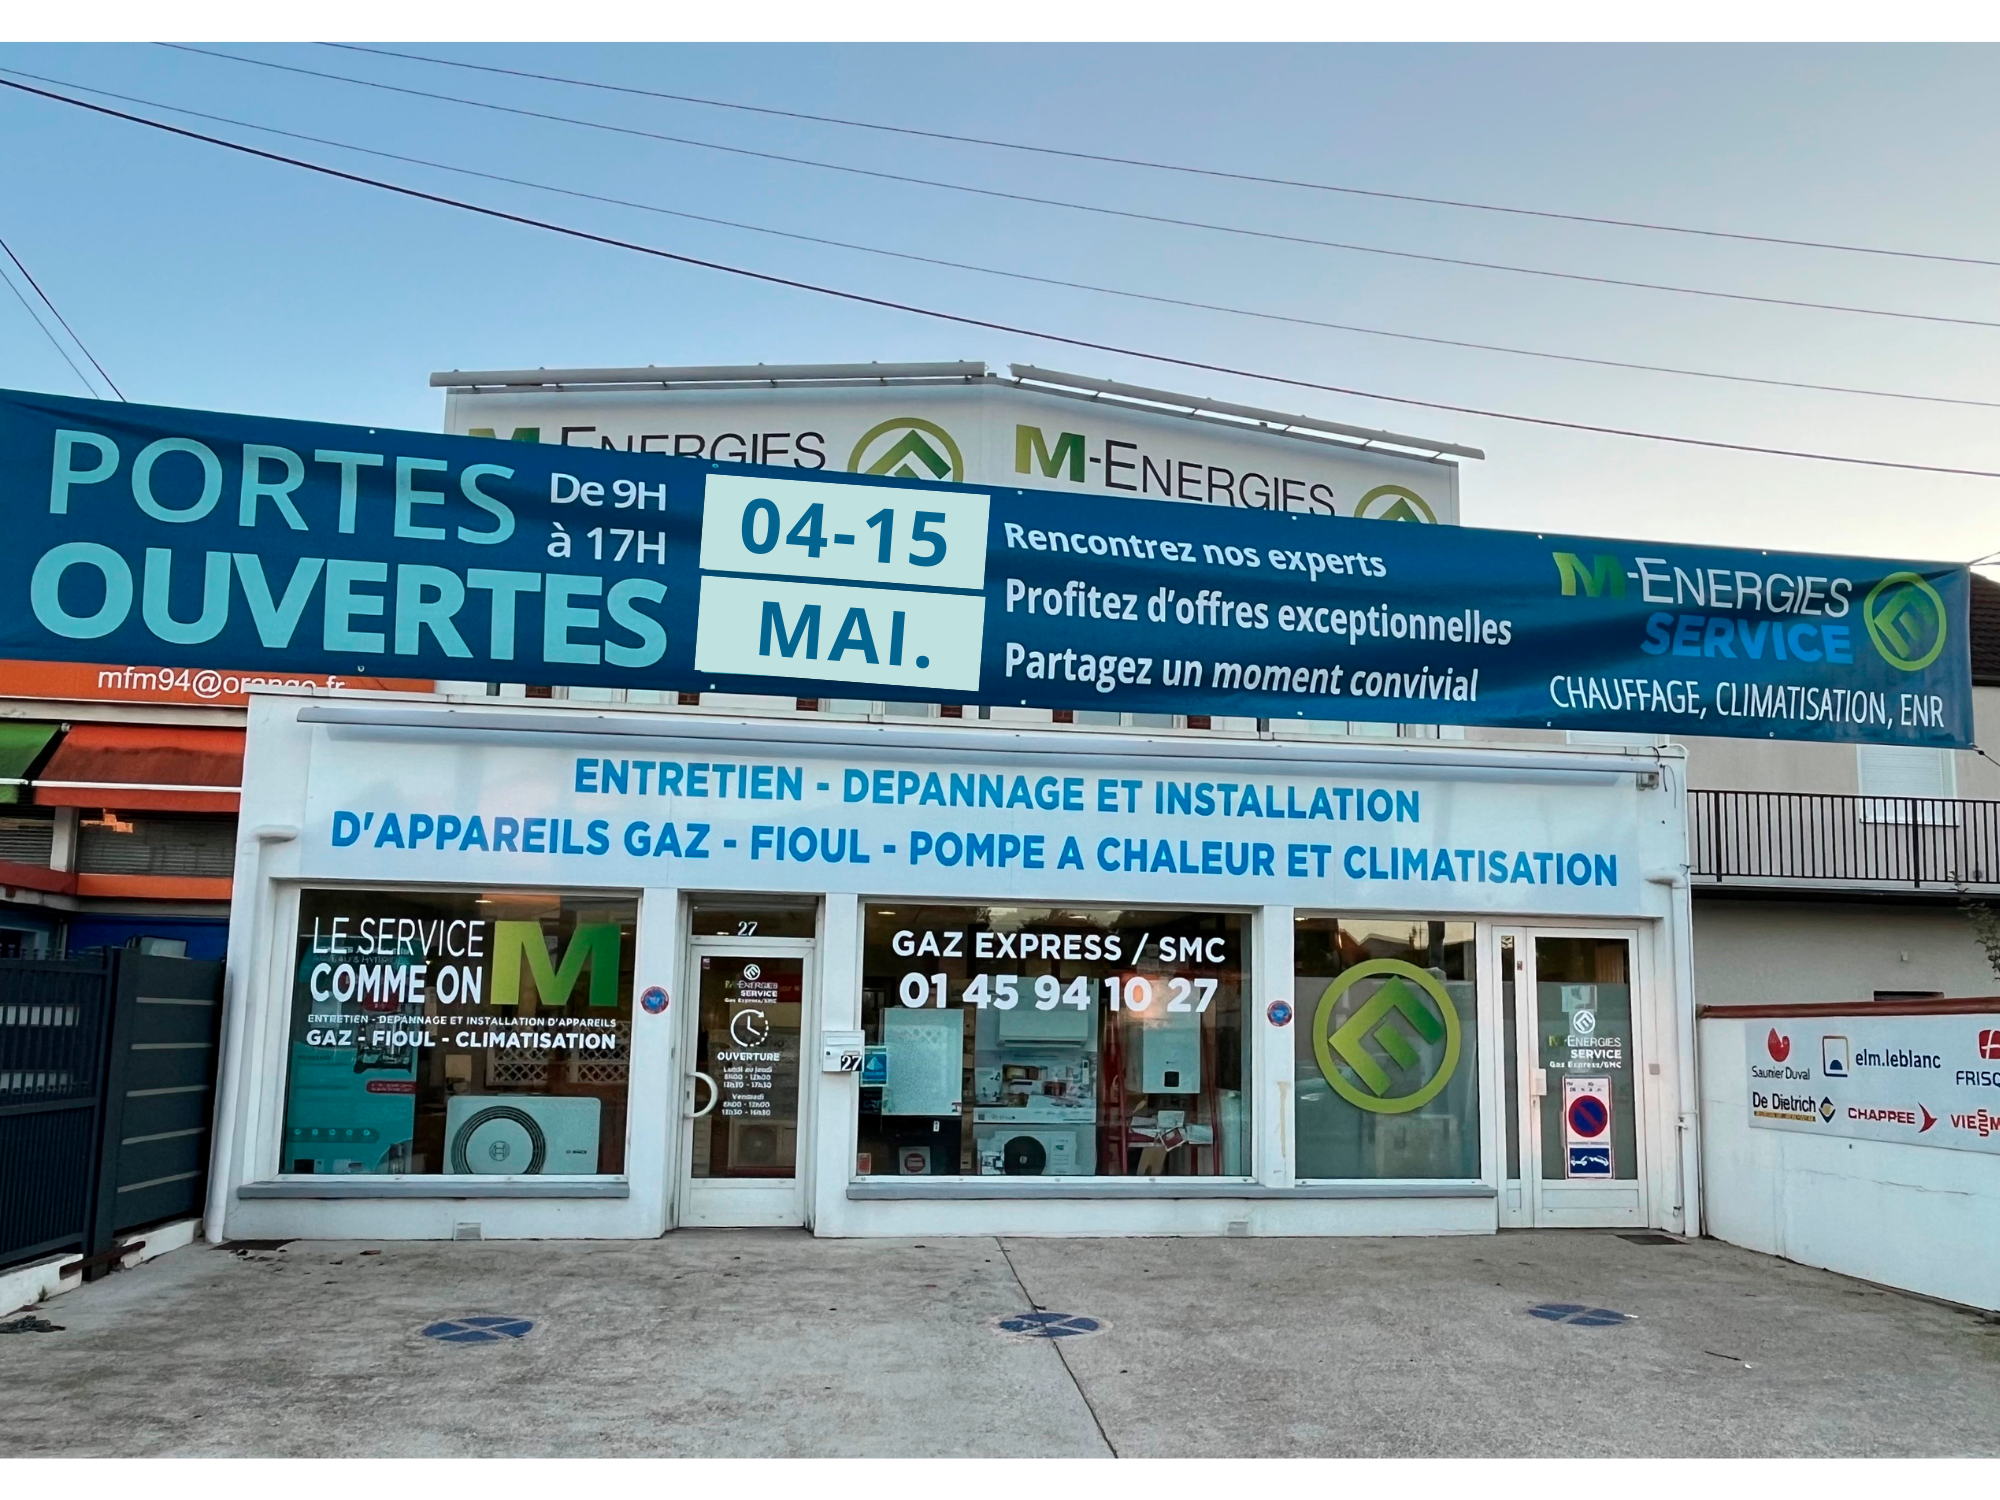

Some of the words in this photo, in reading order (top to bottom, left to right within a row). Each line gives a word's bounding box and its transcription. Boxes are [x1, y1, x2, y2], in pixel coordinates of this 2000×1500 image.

[48, 428, 517, 545] PORTES
[549, 472, 605, 507] De
[611, 480, 667, 511] 9H
[547, 521, 572, 558] à
[586, 528, 667, 565] 17H
[740, 498, 949, 567] 04-15
[1004, 522, 1197, 563] Rencontrez
[1203, 544, 1261, 568] nos
[1268, 549, 1387, 582] experts
[30, 541, 668, 668] OUVERTES
[1006, 578, 1139, 621] Profitez
[1278, 603, 1512, 646] exceptionnelles
[758, 600, 932, 669] MAI.
[1640, 612, 1853, 665] SERVICE
[1005, 642, 1153, 693] Partagez
[1162, 659, 1203, 687] un
[1212, 661, 1344, 695] moment
[1350, 666, 1479, 702] convivial
[1550, 675, 1707, 720] CHAUFFAGE,
[1716, 681, 1894, 731] CLIMATISATION,
[1900, 694, 1944, 728] ENR
[574, 758, 803, 801] ENTRETIEN
[816, 781, 831, 791] -
[844, 768, 1084, 811] DEPANNAGE
[1097, 779, 1143, 813] ET
[1155, 781, 1420, 823] INSTALLATION
[331, 811, 610, 855] D'APPAREILS
[623, 822, 710, 858] GAZ
[723, 839, 737, 849] -
[750, 826, 870, 863] FIOUL
[883, 844, 896, 854] -
[910, 831, 1045, 869] POMPE
[1057, 836, 1085, 870] A
[1097, 837, 1275, 876] CHALEUR
[1287, 843, 1332, 878] ET
[1343, 845, 1618, 887] CLIMATISATION
[312, 916, 350, 956] LE
[357, 918, 486, 958] SERVICE
[737, 921, 758, 936] 27
[892, 931, 963, 957] GAZ
[975, 932, 1122, 961] EXPRESS
[1131, 933, 1150, 965] /
[1158, 936, 1226, 963] SMC
[310, 963, 428, 1004] COMME
[436, 964, 484, 1004] ON
[490, 920, 622, 1007] M
[899, 972, 947, 1009] 01
[962, 973, 1019, 1010] 45
[1034, 975, 1091, 1011] 94
[1105, 976, 1152, 1012] 10
[1166, 977, 1219, 1013] 27
[306, 1029, 351, 1047] GAZ
[372, 1030, 436, 1048] FIOUL
[455, 1031, 616, 1050] CLIMATISATION
[307, 1014, 369, 1024] ENTRETIEN
[379, 1015, 447, 1025] DEPANNAGE
[450, 1016, 464, 1025] ET
[466, 1016, 546, 1026] INSTALLATION
[717, 1052, 780, 1061] OUVERTURE
[841, 1055, 862, 1071] 27
[1571, 1049, 1622, 1059] SERVICE
[1752, 1066, 1784, 1079] Saunier
[1785, 1067, 1810, 1080] Duval
[1855, 1049, 1941, 1068] elm.leblanc
[1753, 1091, 1768, 1108] De
[1772, 1093, 1816, 1112] Dietrich
[1848, 1107, 1916, 1124] CHAPPEE
